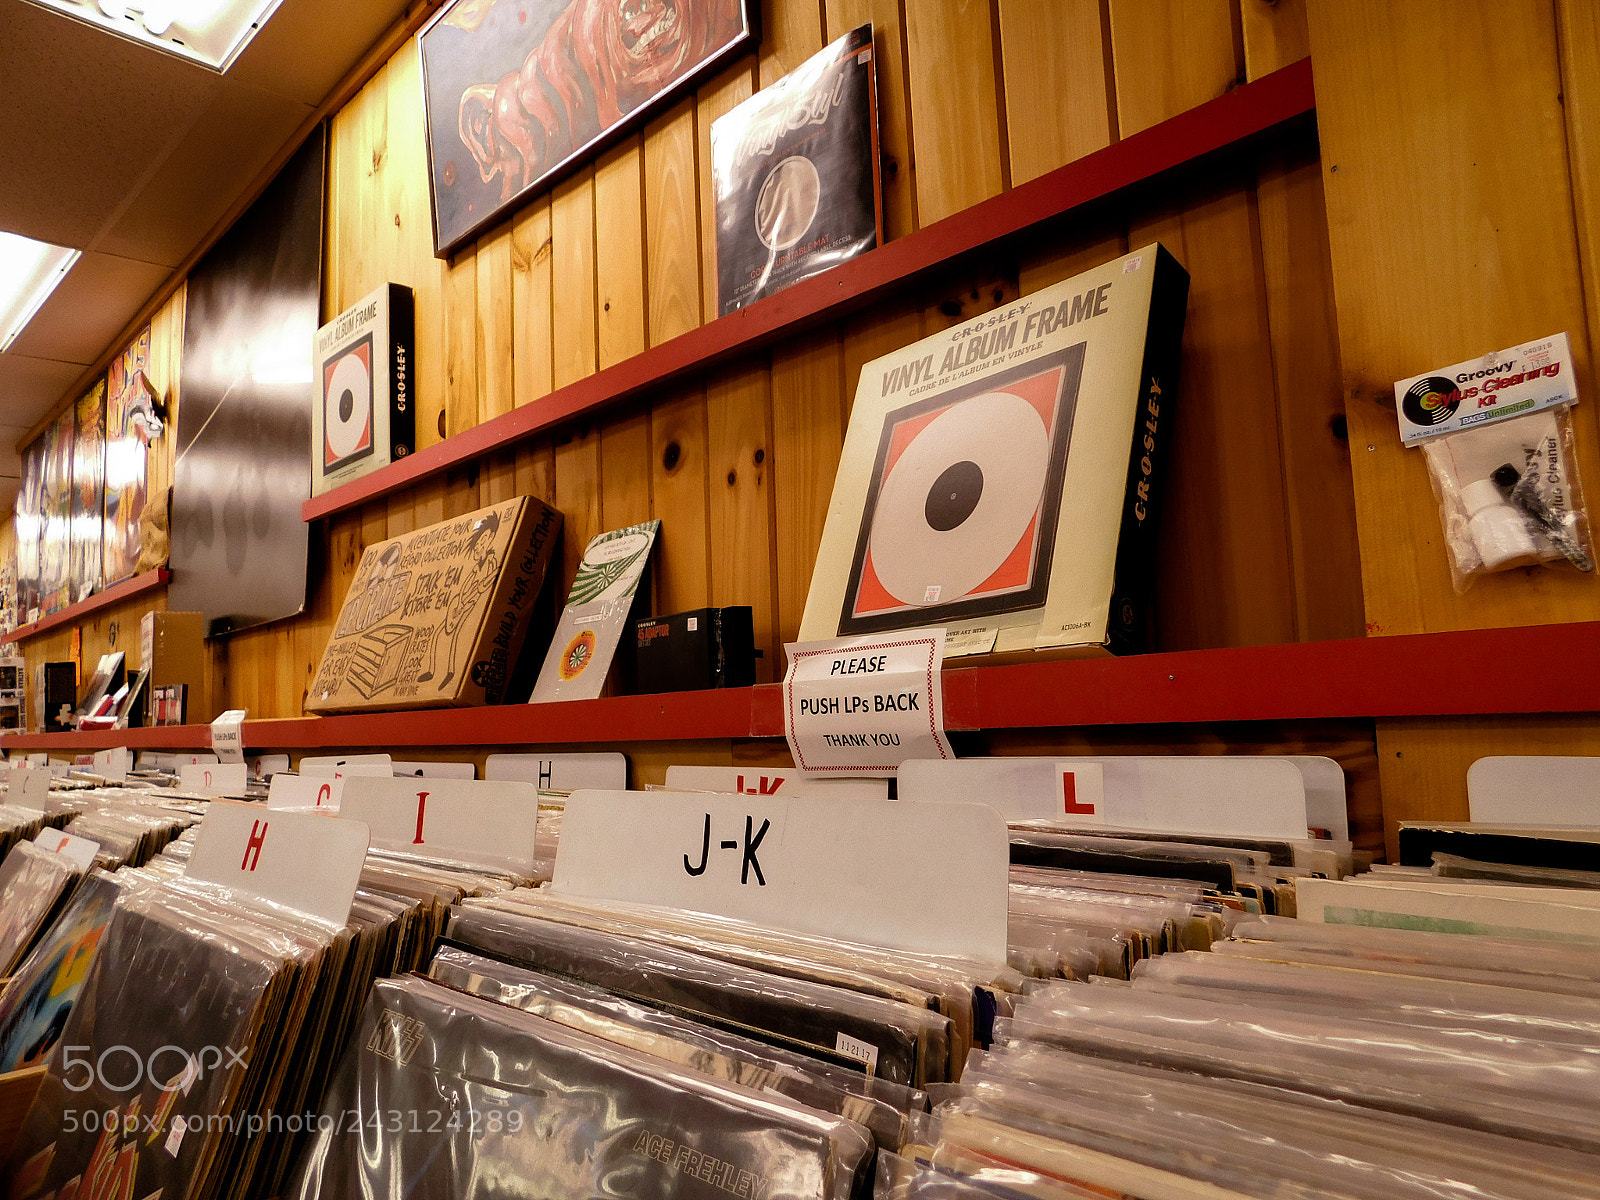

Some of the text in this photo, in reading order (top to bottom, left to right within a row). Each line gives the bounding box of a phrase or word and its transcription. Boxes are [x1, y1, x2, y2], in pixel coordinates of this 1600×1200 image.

[772, 243, 812, 268] URNTABLE
[814, 233, 830, 247] MAT
[335, 315, 355, 341] ALBUM
[355, 301, 377, 329] FRAME
[881, 282, 1113, 398] VINYL ALBUM FRAME
[948, 302, 1033, 342] CROSLEY
[396, 344, 406, 413] CROSLEY
[909, 340, 1043, 397] CADRE DE L'ALBUM EN VINYLE
[1425, 361, 1561, 408] Stylus Cleaning
[1456, 360, 1515, 384] Groovy
[1462, 399, 1532, 425] BAGS Unlimited
[1477, 394, 1498, 408] Kit
[1133, 375, 1163, 523] CROSLEY
[1547, 438, 1560, 484] Cleaner
[449, 518, 473, 540] YOUR
[411, 565, 464, 597] STACK 'EM
[493, 505, 556, 650] BUILD YOUR COLLECTION
[434, 589, 452, 610] 'EM
[645, 623, 670, 640] ADAPTOR
[403, 654, 425, 670] LOOK
[830, 655, 887, 676] PLEASE
[800, 692, 920, 715] PUSH LPs BACK
[823, 733, 901, 747] THANK YOU
[539, 760, 552, 789] H
[1062, 771, 1095, 815] L
[412, 791, 430, 844] I
[241, 818, 269, 872] H
[682, 811, 771, 886] J-K
[366, 1007, 425, 1067] KISS
[851, 1044, 859, 1056] 21
[861, 1048, 871, 1061] 17
[633, 1129, 769, 1200] ACE FREHLEY
